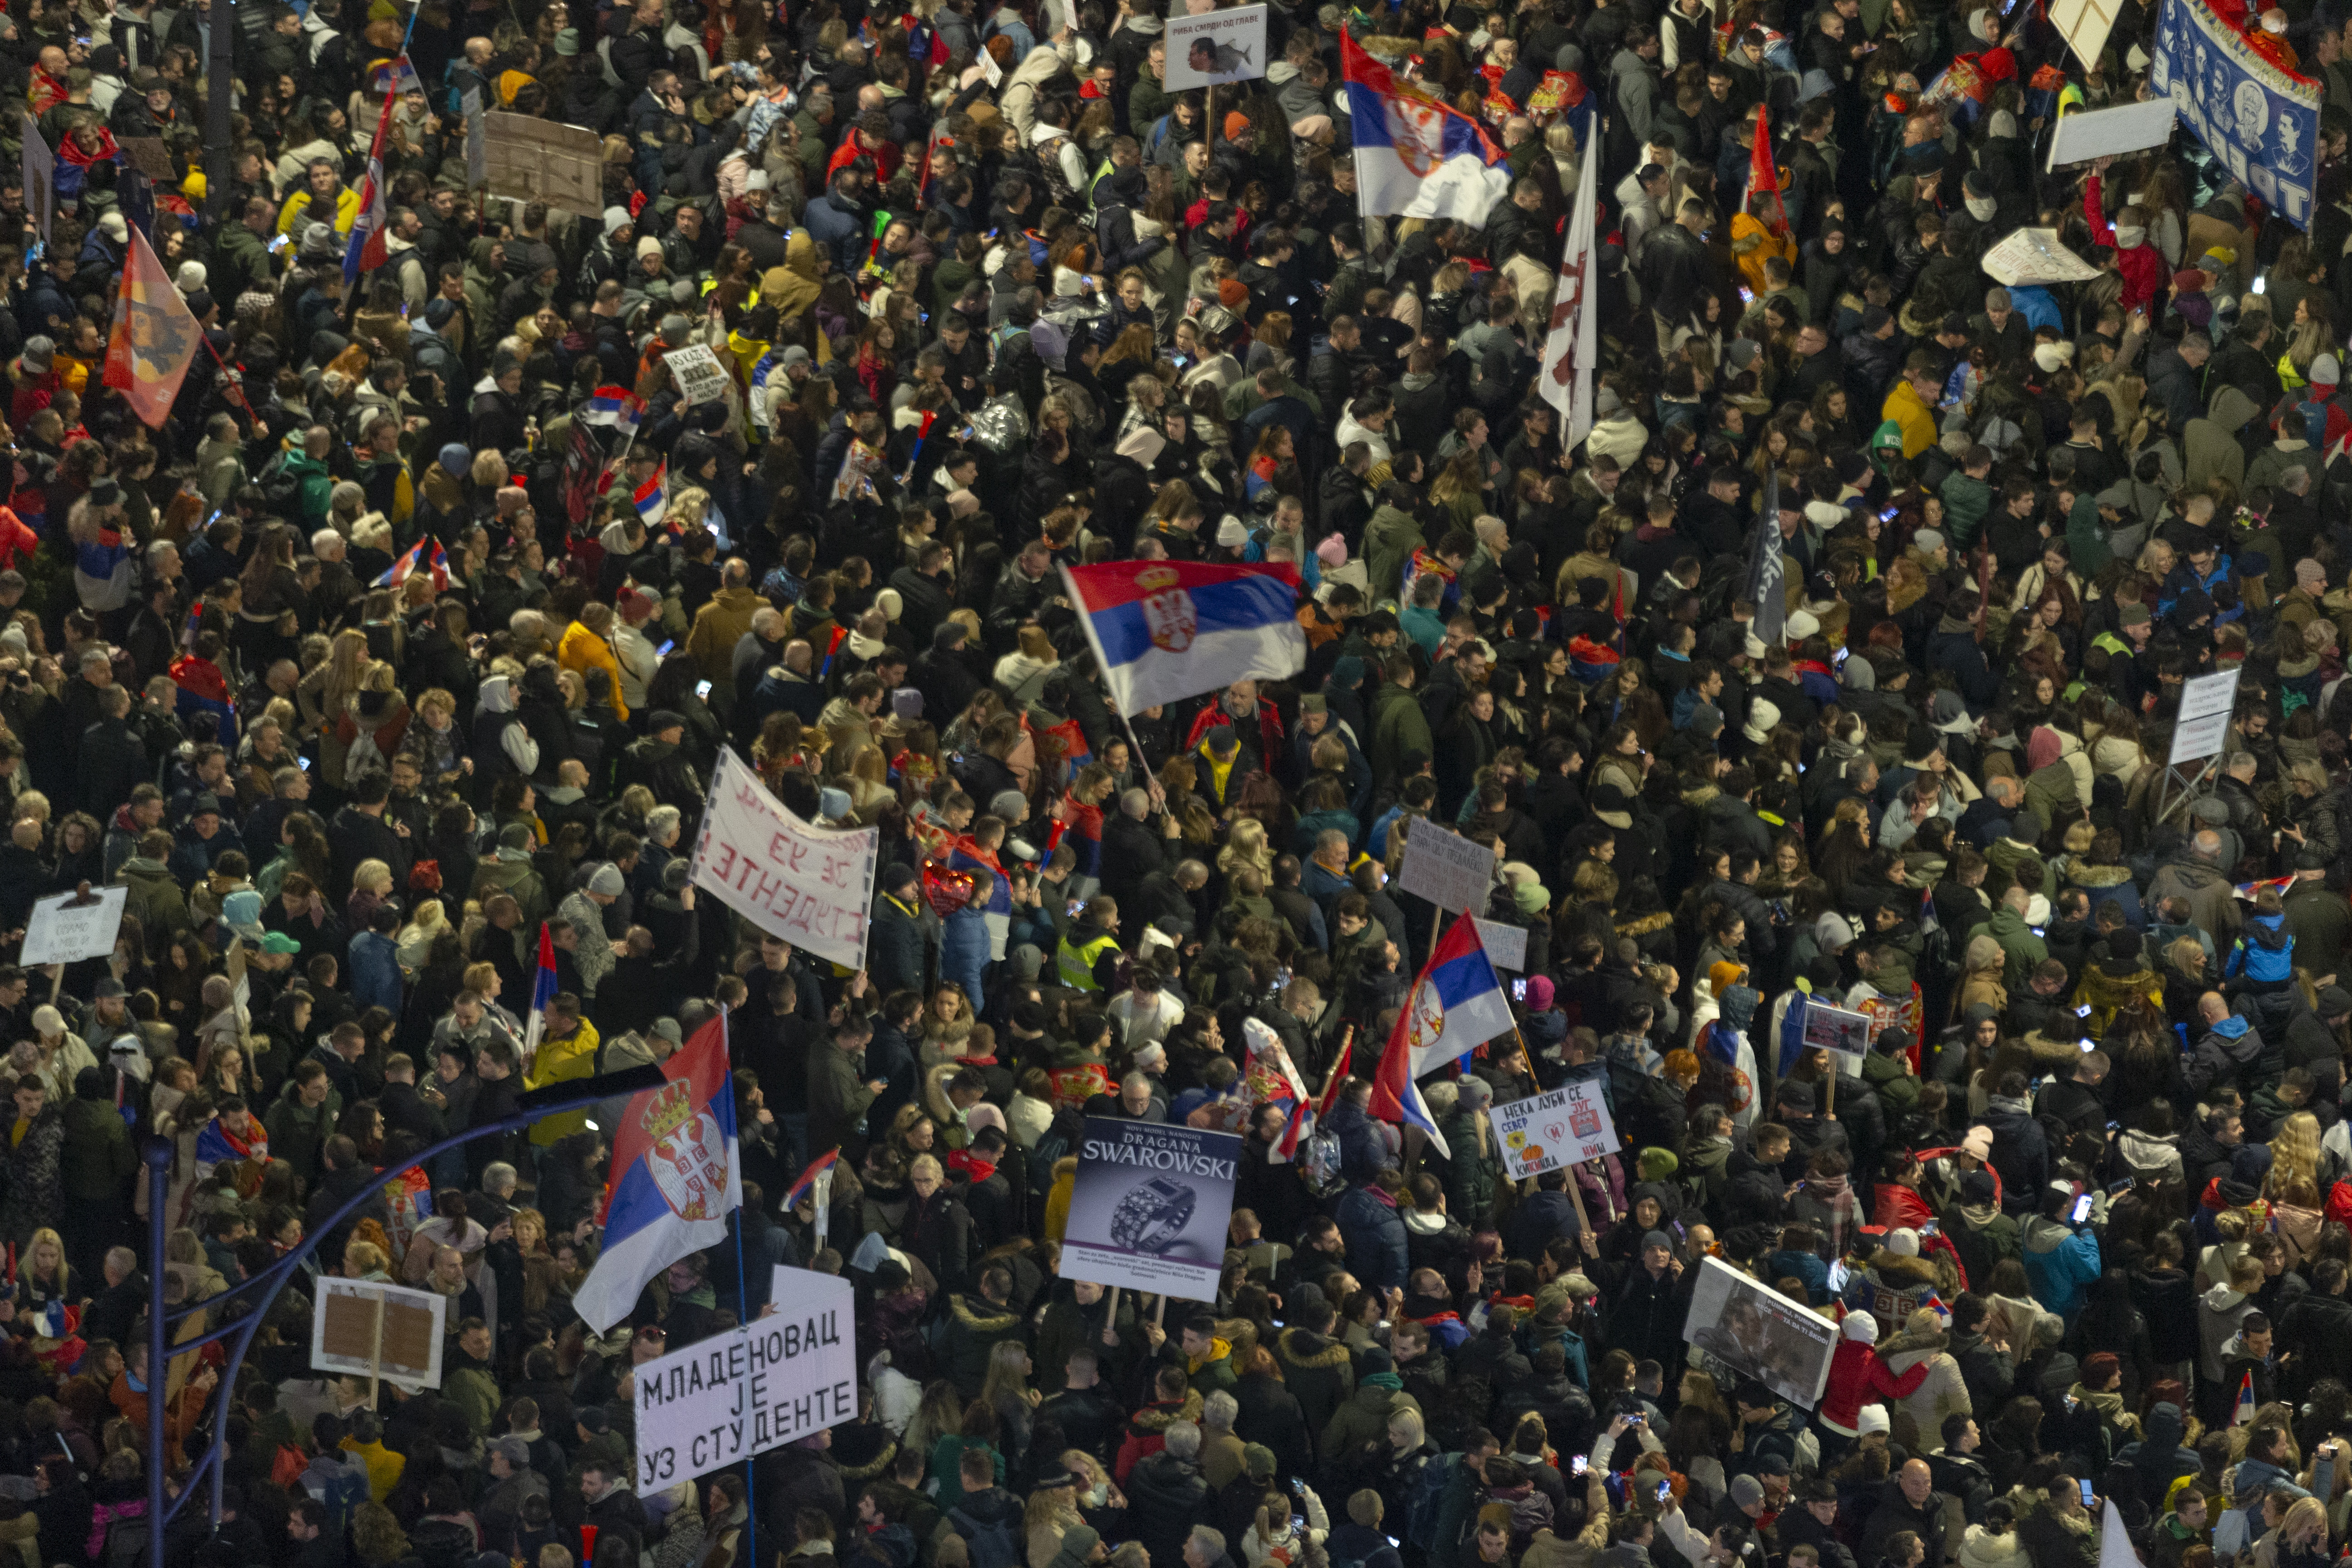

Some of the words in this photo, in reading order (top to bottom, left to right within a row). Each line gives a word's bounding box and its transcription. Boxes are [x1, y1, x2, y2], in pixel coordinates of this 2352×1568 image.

[1173, 25, 1193, 36] РИБА
[1195, 22, 1222, 33] СМРДИ
[1223, 20, 1235, 29] ОД
[1235, 15, 1259, 26] ГЛАВЕ
[1409, 834, 1430, 850] СТВАРИ
[1431, 843, 1445, 857] ОДУ
[1470, 847, 1483, 860] ДА
[1503, 1101, 1535, 1120] НЕКА
[1568, 1085, 1584, 1102] СЕ
[1570, 1098, 1592, 1114] ЈУГ
[1144, 1127, 1166, 1136] MODEL
[1169, 1130, 1202, 1141] NANOGICE
[1501, 1117, 1529, 1133] СЕВЕР
[1550, 1126, 1561, 1138] И
[1124, 1133, 1201, 1154] DRAGANA
[1582, 1142, 1607, 1157] НИШ
[1083, 1139, 1236, 1181] SWAROWSKI
[1515, 1155, 1559, 1177] КИКИНДА
[1767, 1298, 1793, 1318] PUMPAJ,
[1794, 1313, 1821, 1335] PUMPAJ!
[1791, 1321, 1800, 1332] DA
[1801, 1326, 1808, 1336] TI
[1808, 1330, 1828, 1349] ŠKODI
[643, 1309, 840, 1410] МЛАДЕНОВАЦ
[731, 1372, 768, 1416] ЈЕ
[644, 1447, 676, 1486] УЗ
[691, 1380, 852, 1469] СТУДЕНТЕ
